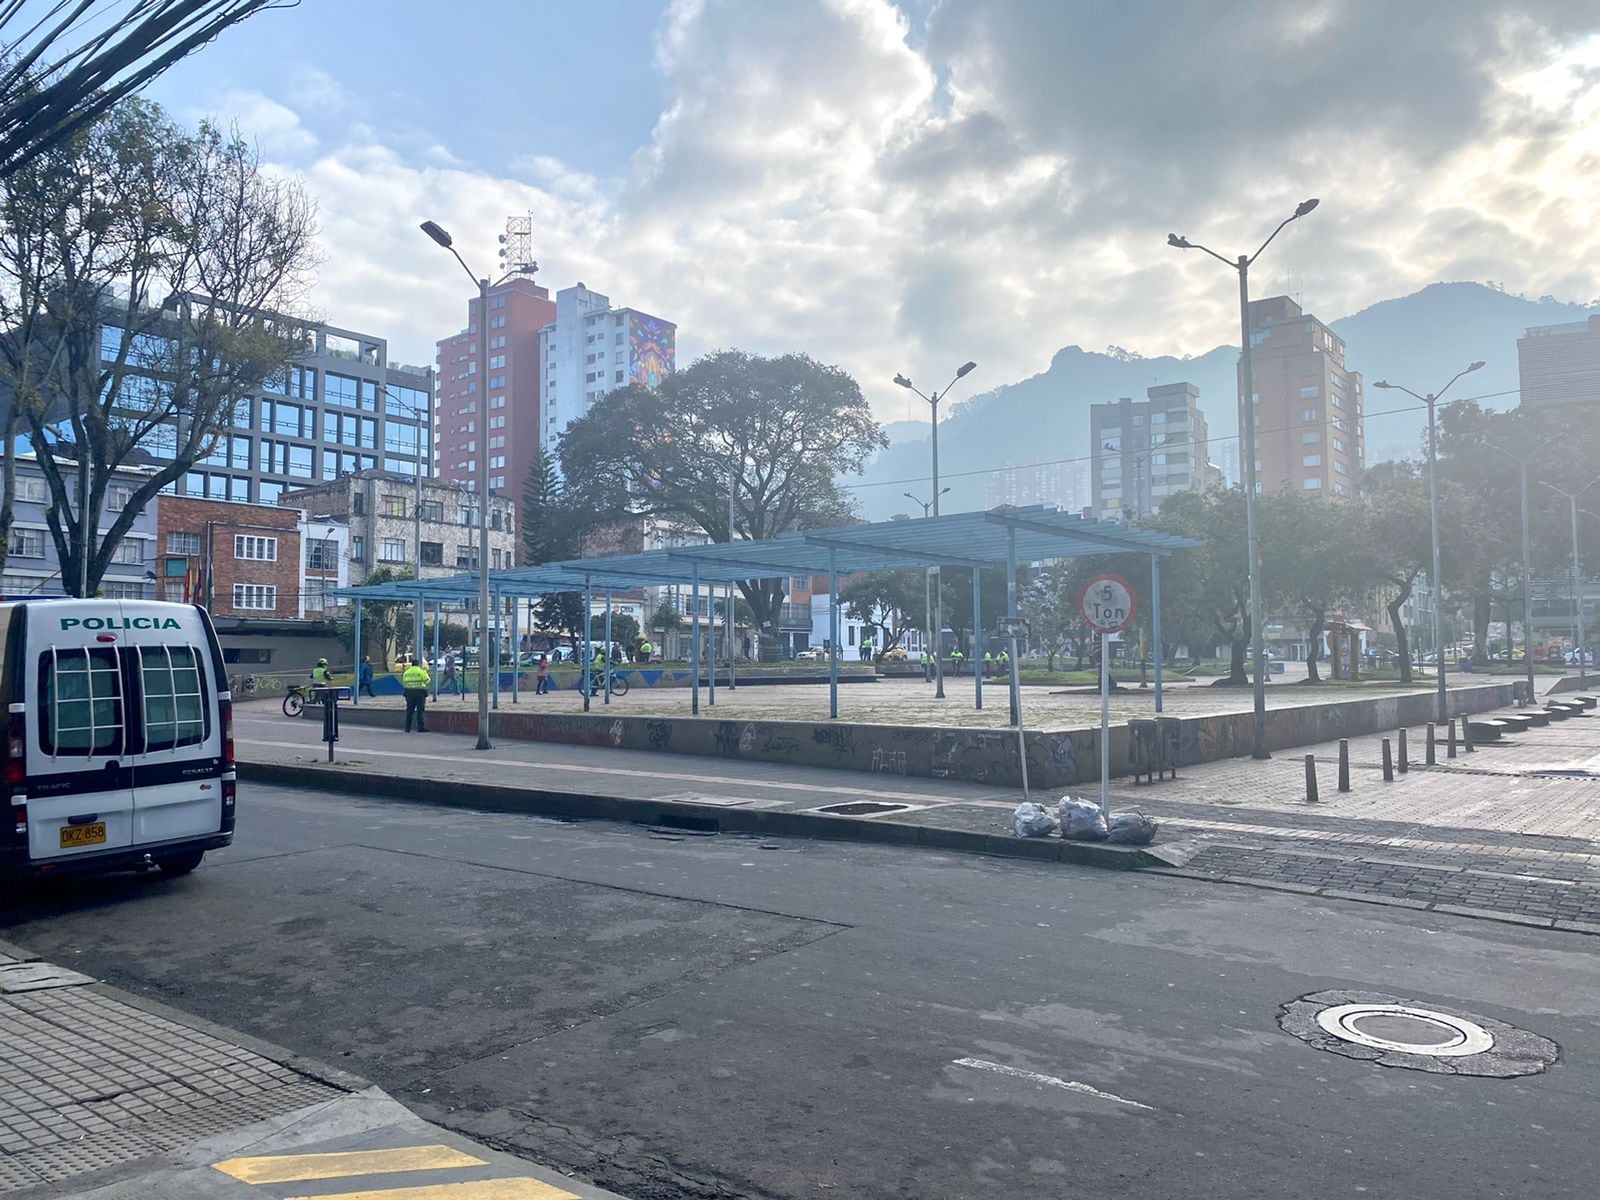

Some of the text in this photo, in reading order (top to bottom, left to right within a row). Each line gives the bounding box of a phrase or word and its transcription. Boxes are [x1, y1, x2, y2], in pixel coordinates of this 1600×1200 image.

[1103, 585, 1113, 601] 5
[1093, 603, 1124, 619] Ton
[60, 618, 181, 630] POLICIA
[85, 825, 104, 839] 858
